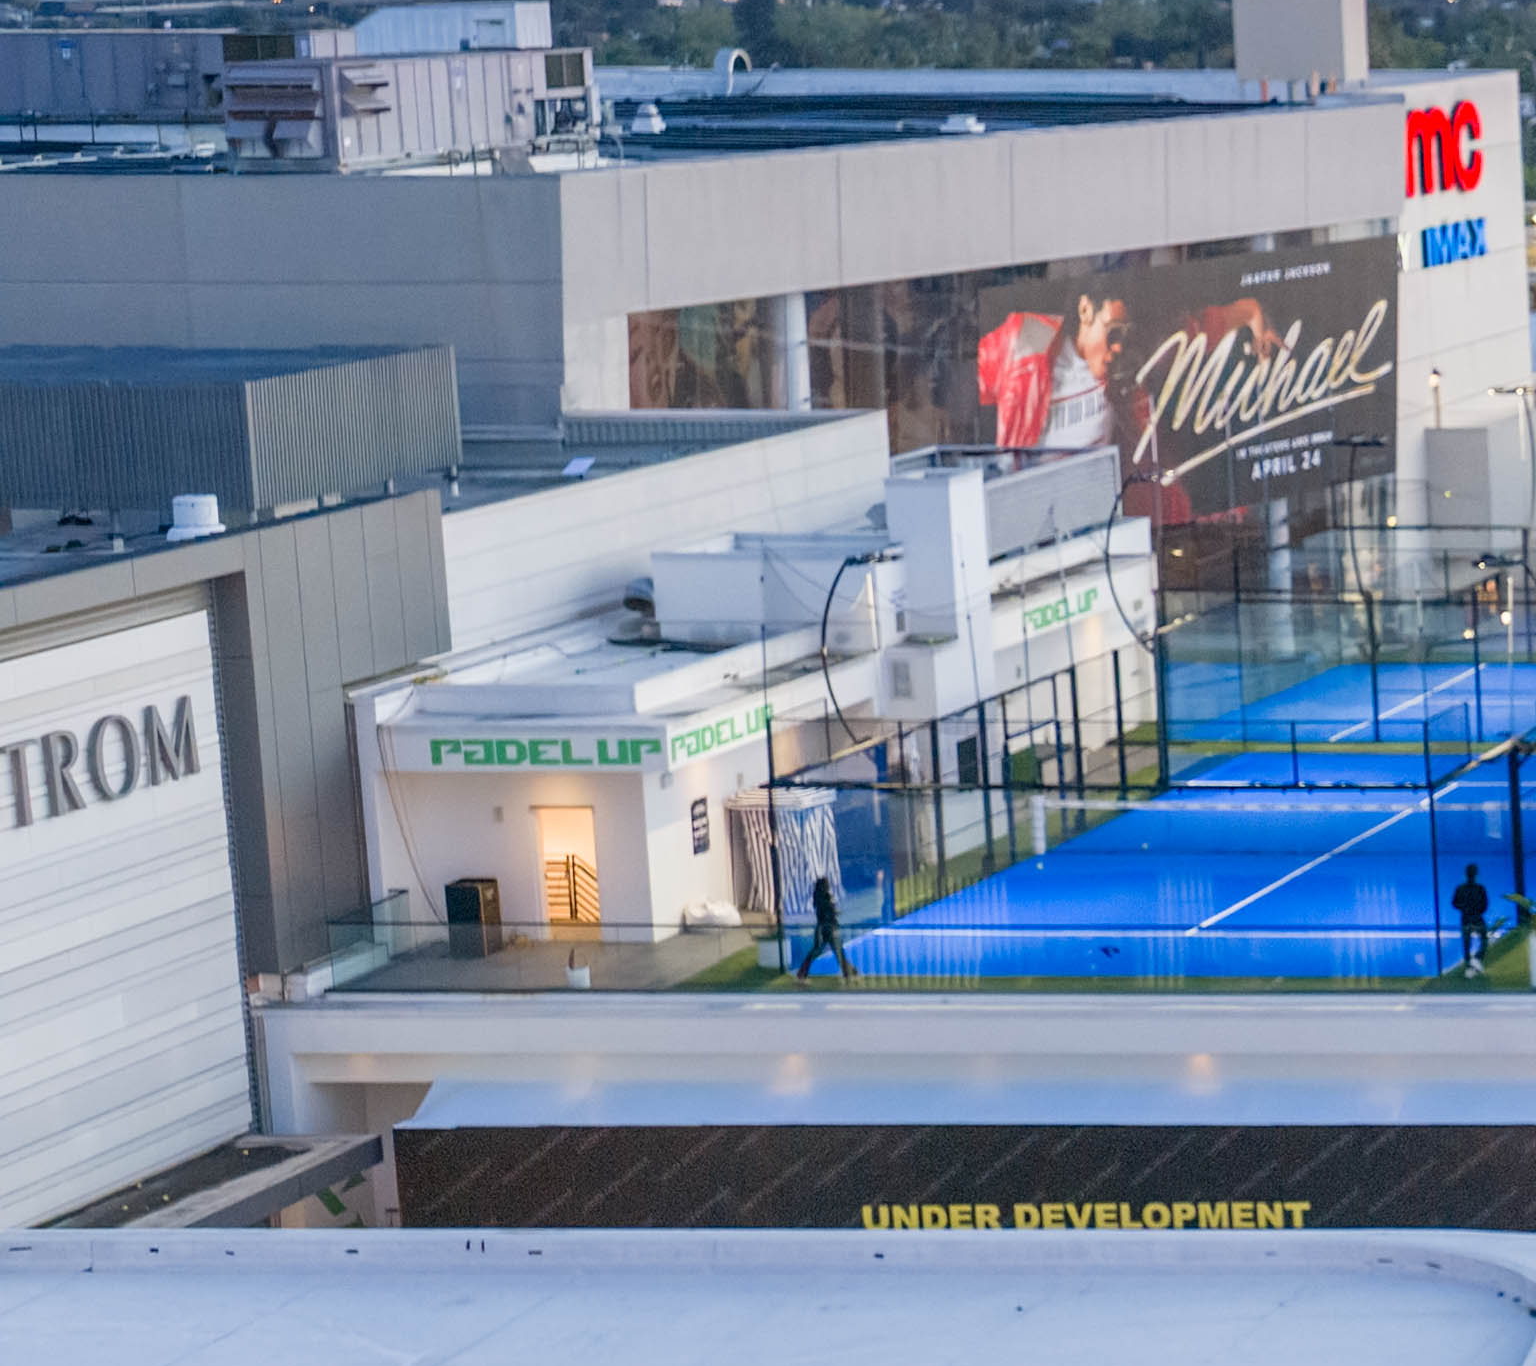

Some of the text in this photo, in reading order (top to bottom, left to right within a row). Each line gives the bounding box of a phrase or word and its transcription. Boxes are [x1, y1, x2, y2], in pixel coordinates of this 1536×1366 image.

[1421, 216, 1488, 269] IMAX
[1133, 299, 1393, 464] Michael
[1251, 448, 1322, 482] APRIL 24
[0, 695, 201, 828] TROM
[597, 738, 662, 766] UP
[862, 1201, 1312, 1229] UNDER DEVELOPMENT
